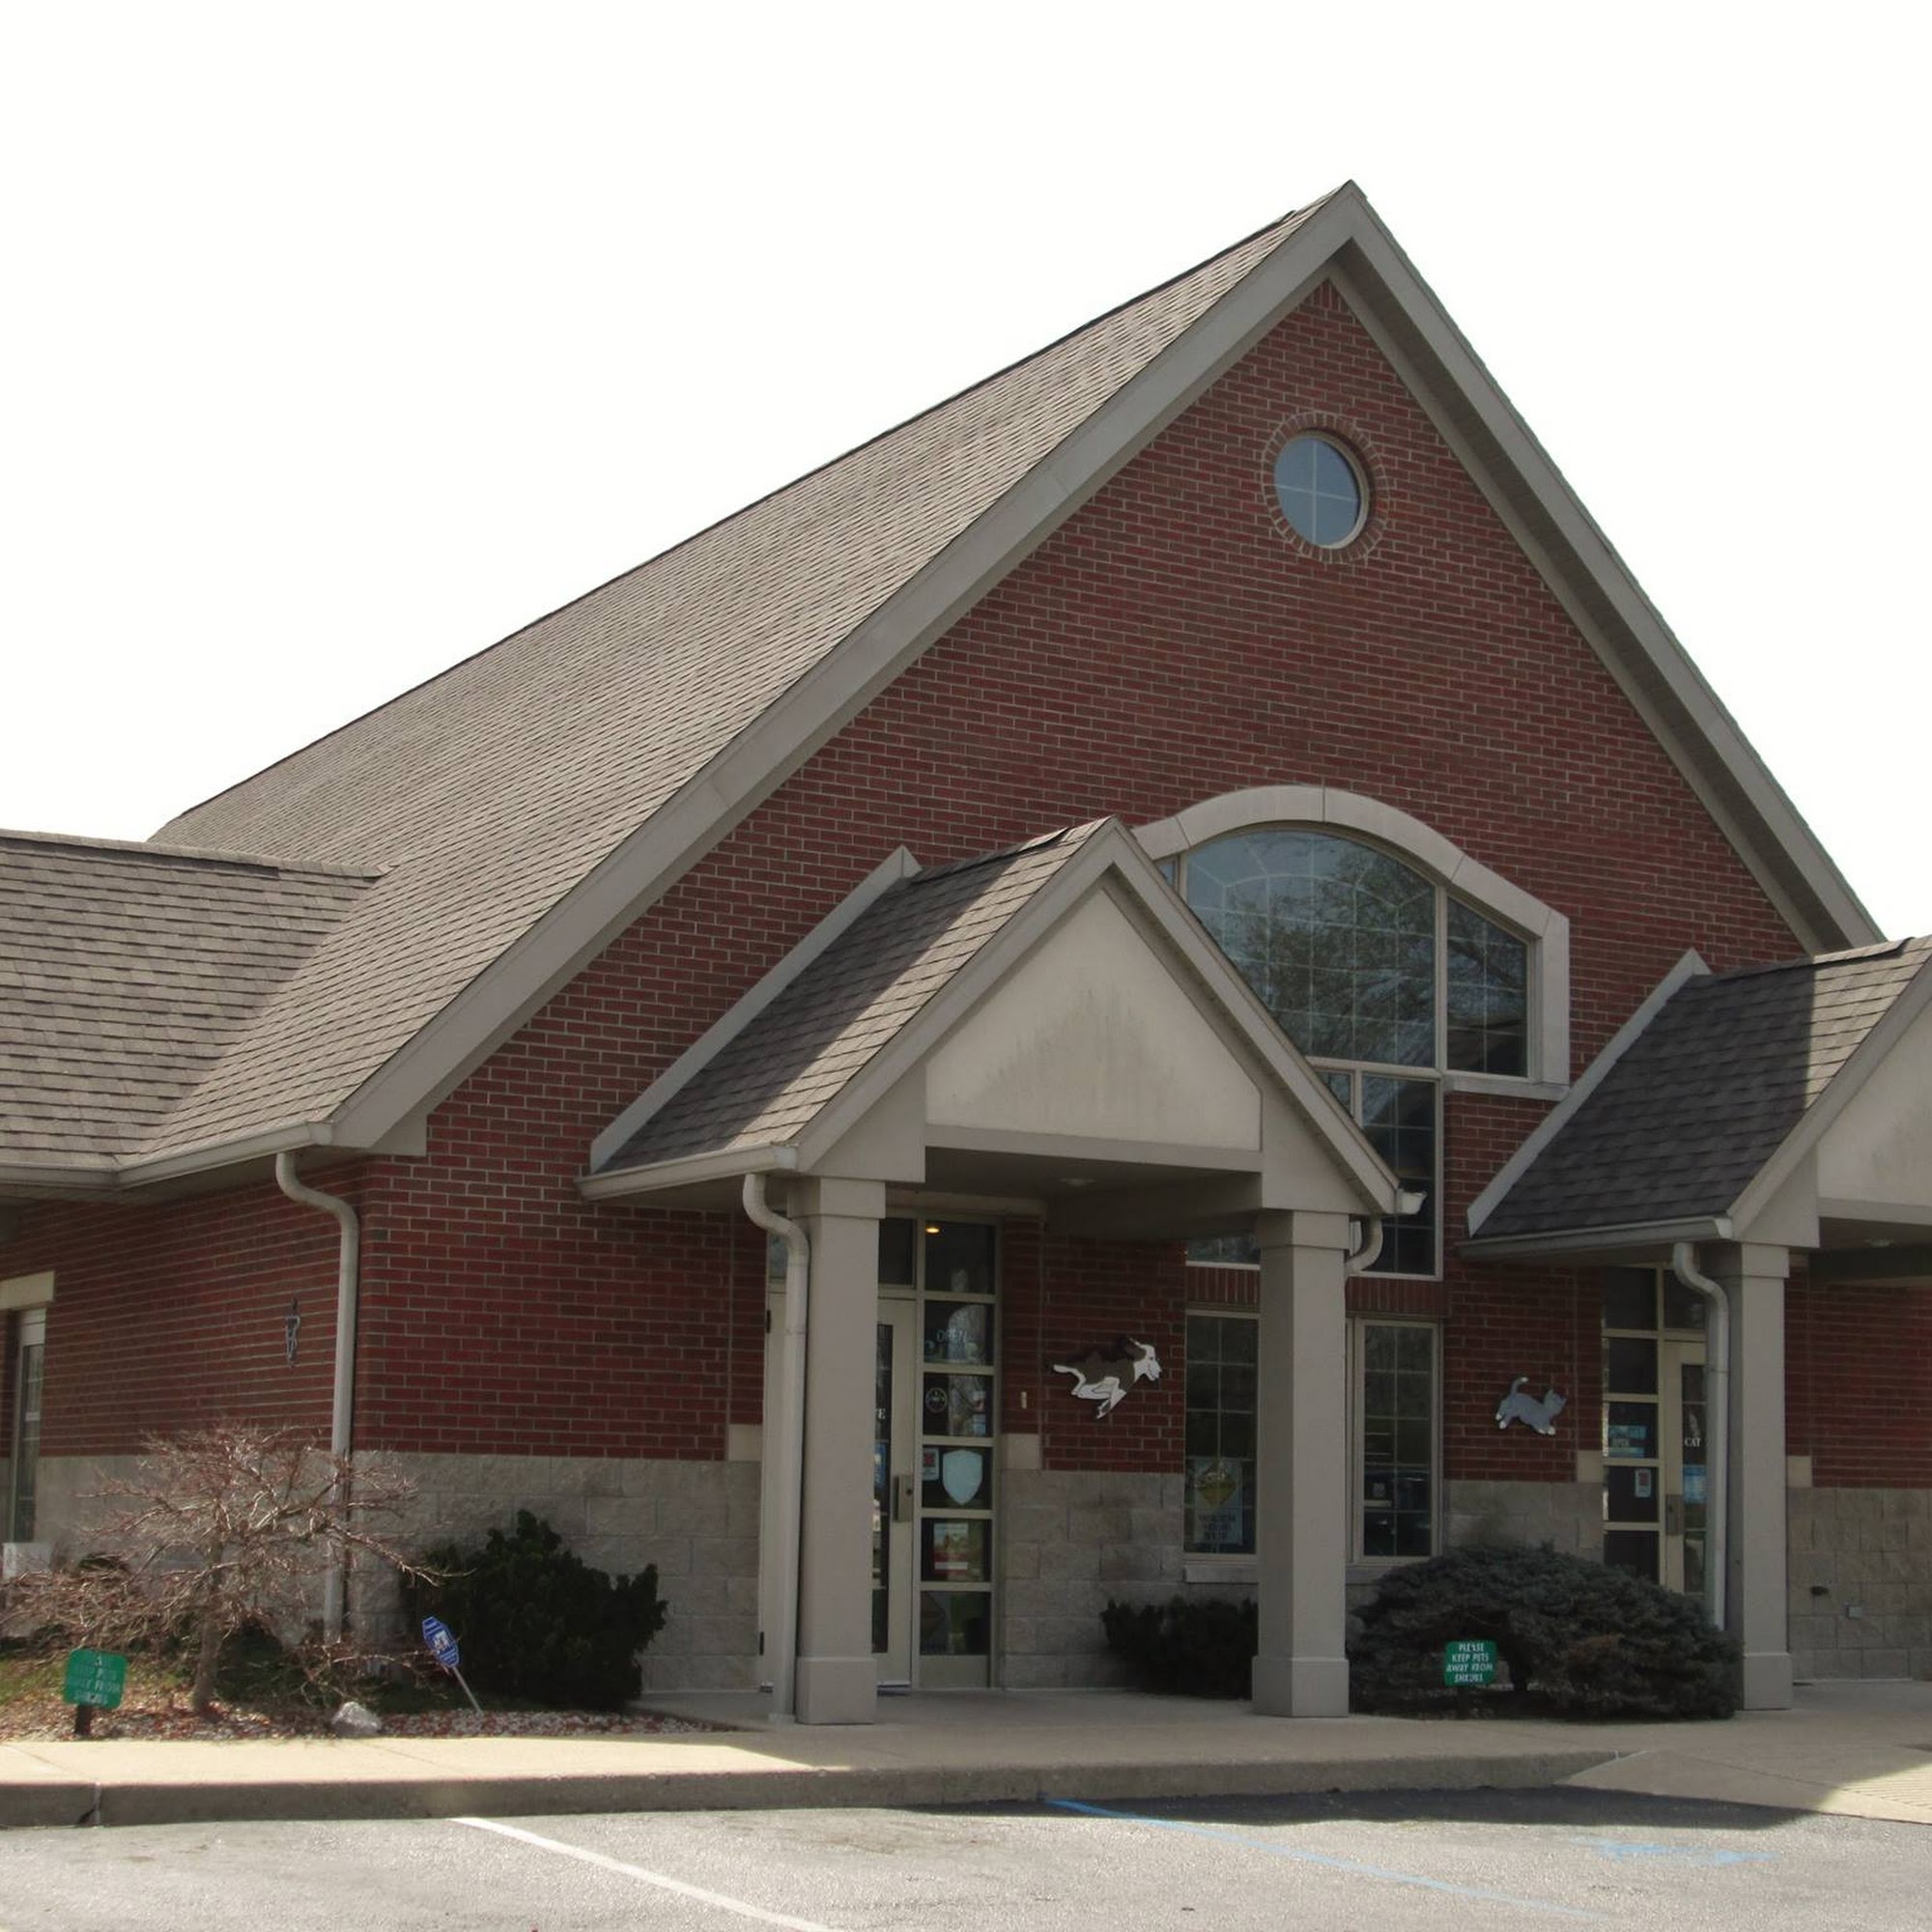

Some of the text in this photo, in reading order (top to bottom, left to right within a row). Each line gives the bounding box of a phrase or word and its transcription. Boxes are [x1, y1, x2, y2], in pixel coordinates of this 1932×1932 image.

[1685, 1437, 1701, 1447] CAT
[1459, 1643, 1485, 1652] PLEASE
[1452, 1653, 1489, 1662] KEEP PETS
[1446, 1663, 1493, 1672] AWAY FROM
